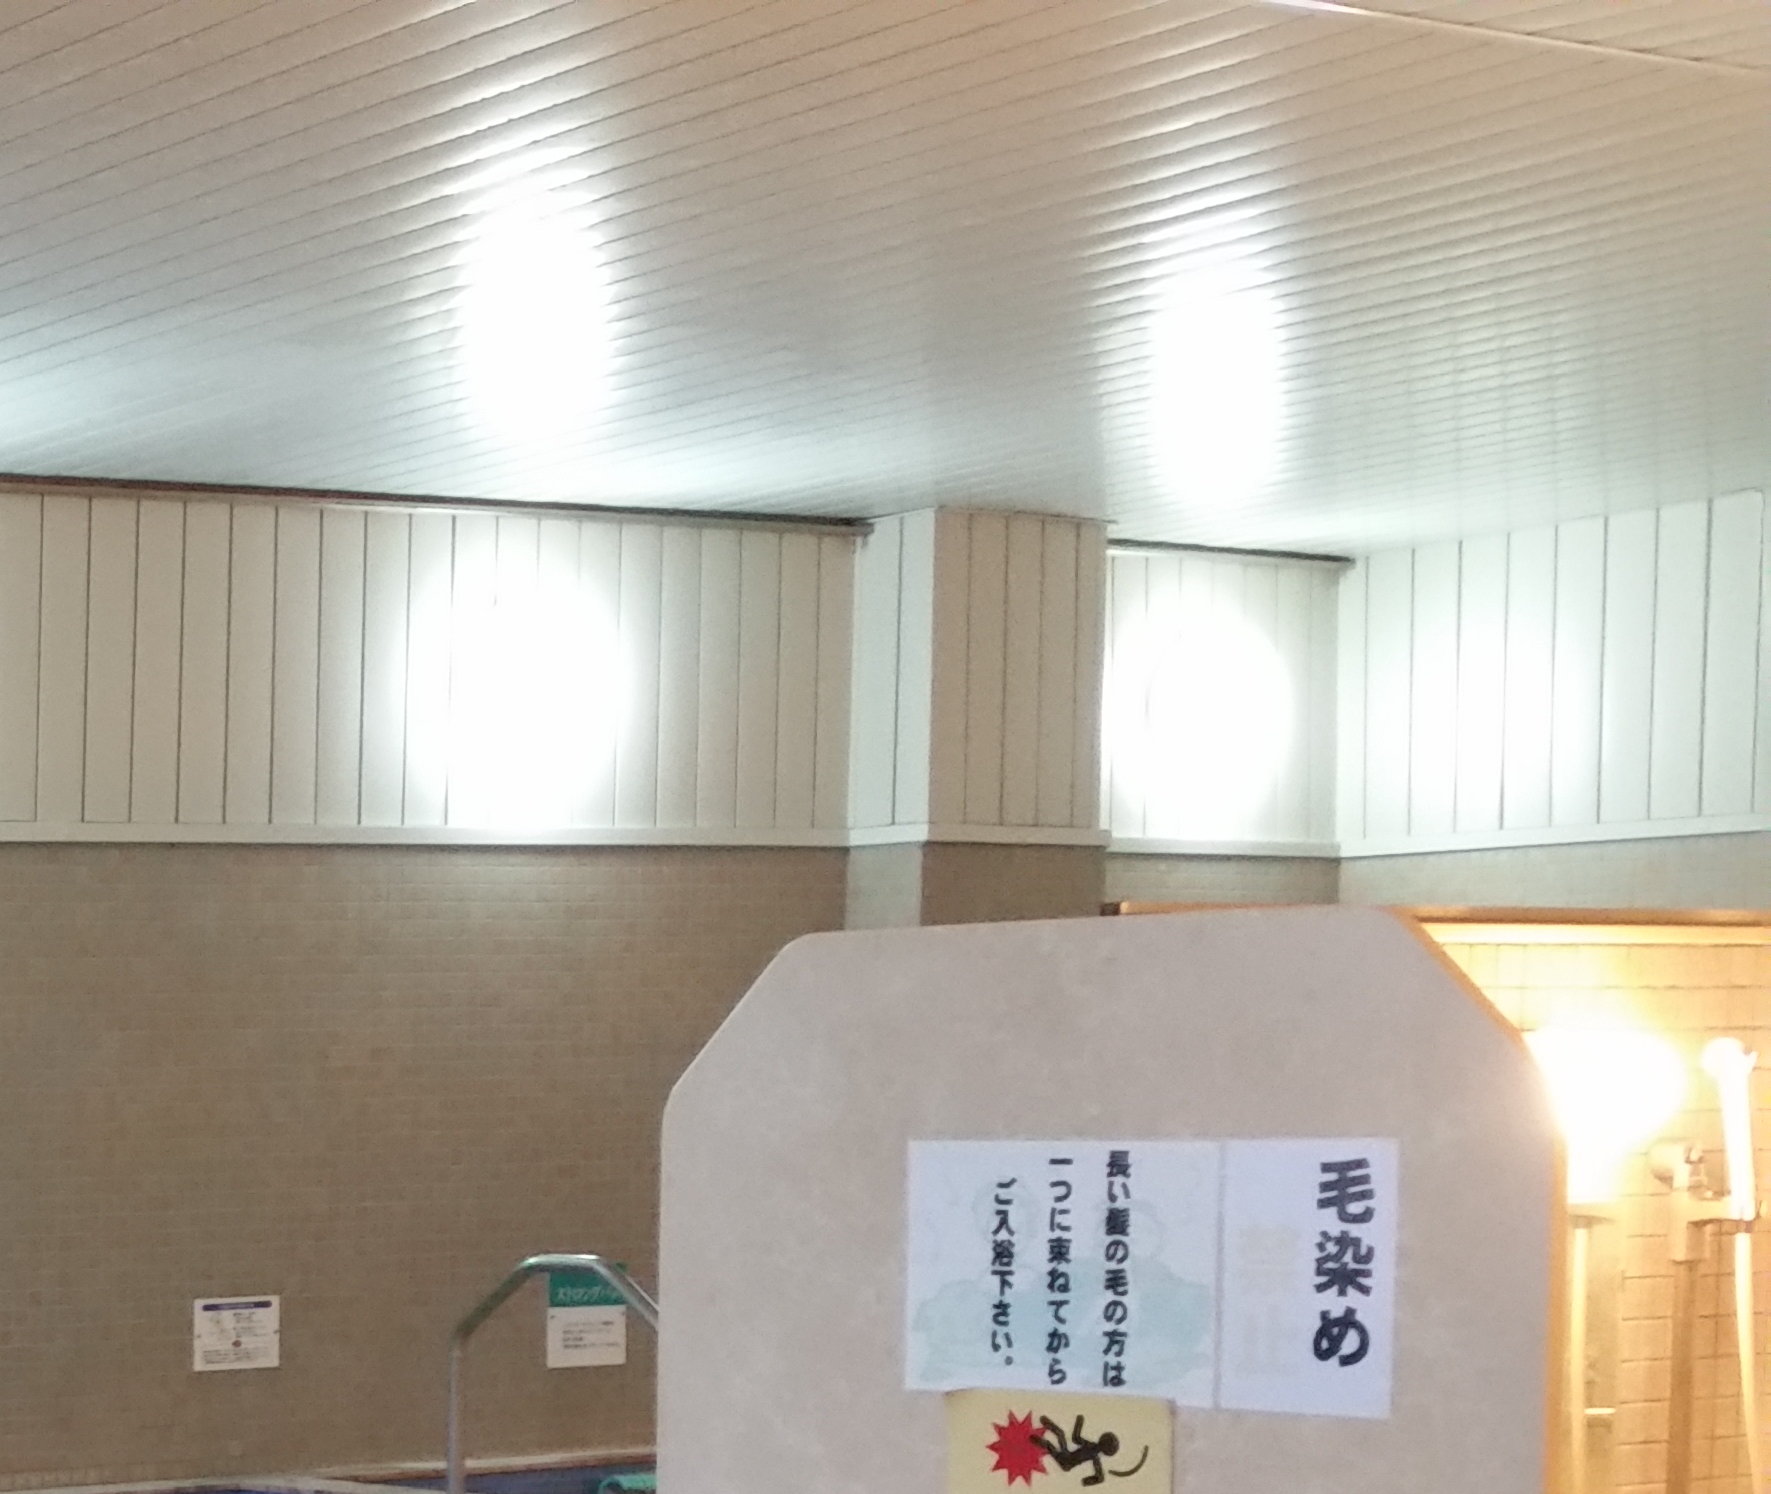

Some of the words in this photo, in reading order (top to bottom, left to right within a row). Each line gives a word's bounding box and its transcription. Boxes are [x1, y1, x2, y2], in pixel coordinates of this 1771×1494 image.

[990, 1177, 1018, 1367] ご入浴下さい。
[1045, 1157, 1075, 1386] 一つに束ねてから
[1102, 1149, 1132, 1389] 長い髪の毛の方は
[1312, 1157, 1376, 1368] 毛染め
